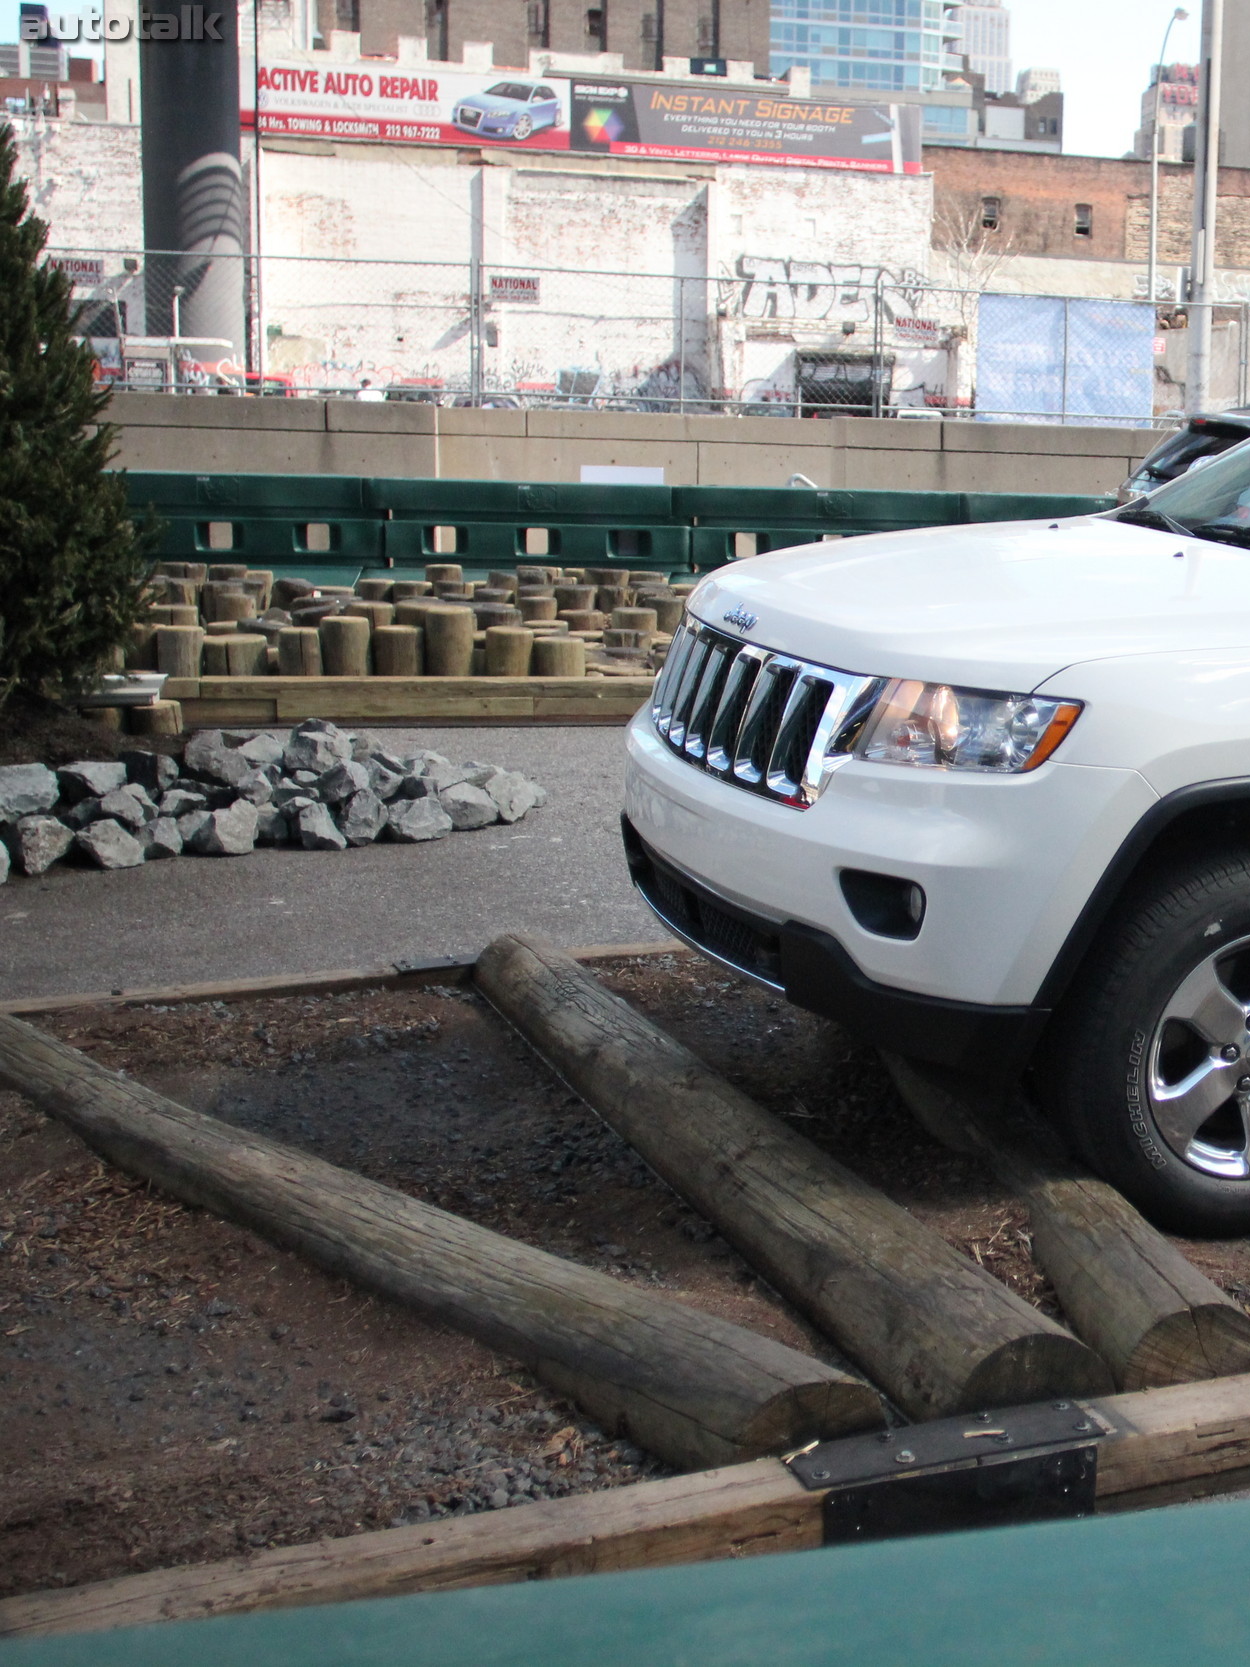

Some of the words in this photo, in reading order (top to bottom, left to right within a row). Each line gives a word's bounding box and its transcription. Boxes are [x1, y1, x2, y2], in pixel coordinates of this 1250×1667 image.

[257, 67, 319, 93] ACTIVE
[323, 72, 374, 97] AUTO
[379, 76, 439, 101] REPAIR
[651, 91, 751, 115] INSTANT
[755, 100, 857, 124] SIGNAGE
[268, 117, 286, 129] Hrs.
[287, 117, 322, 132] TOWING
[324, 120, 331, 132] &
[332, 121, 379, 136] LOCKSMITH
[386, 125, 400, 137] 212
[663, 114, 719, 124] EVERYTHING
[720, 118, 738, 126] YOU
[739, 120, 761, 128] NEED
[762, 121, 780, 129] FOR
[782, 122, 805, 131] YOUR
[806, 124, 836, 133] BOOTH
[681, 125, 730, 135] DELIVERED
[732, 128, 744, 136] TO
[745, 129, 763, 138] YOU
[764, 130, 774, 138] IN
[774, 130, 783, 139] 3
[783, 132, 814, 141] HOURS
[491, 278, 537, 290] NATIONAL
[896, 316, 938, 331] NATIONAL
[1126, 1031, 1168, 1171] MICHELIN
